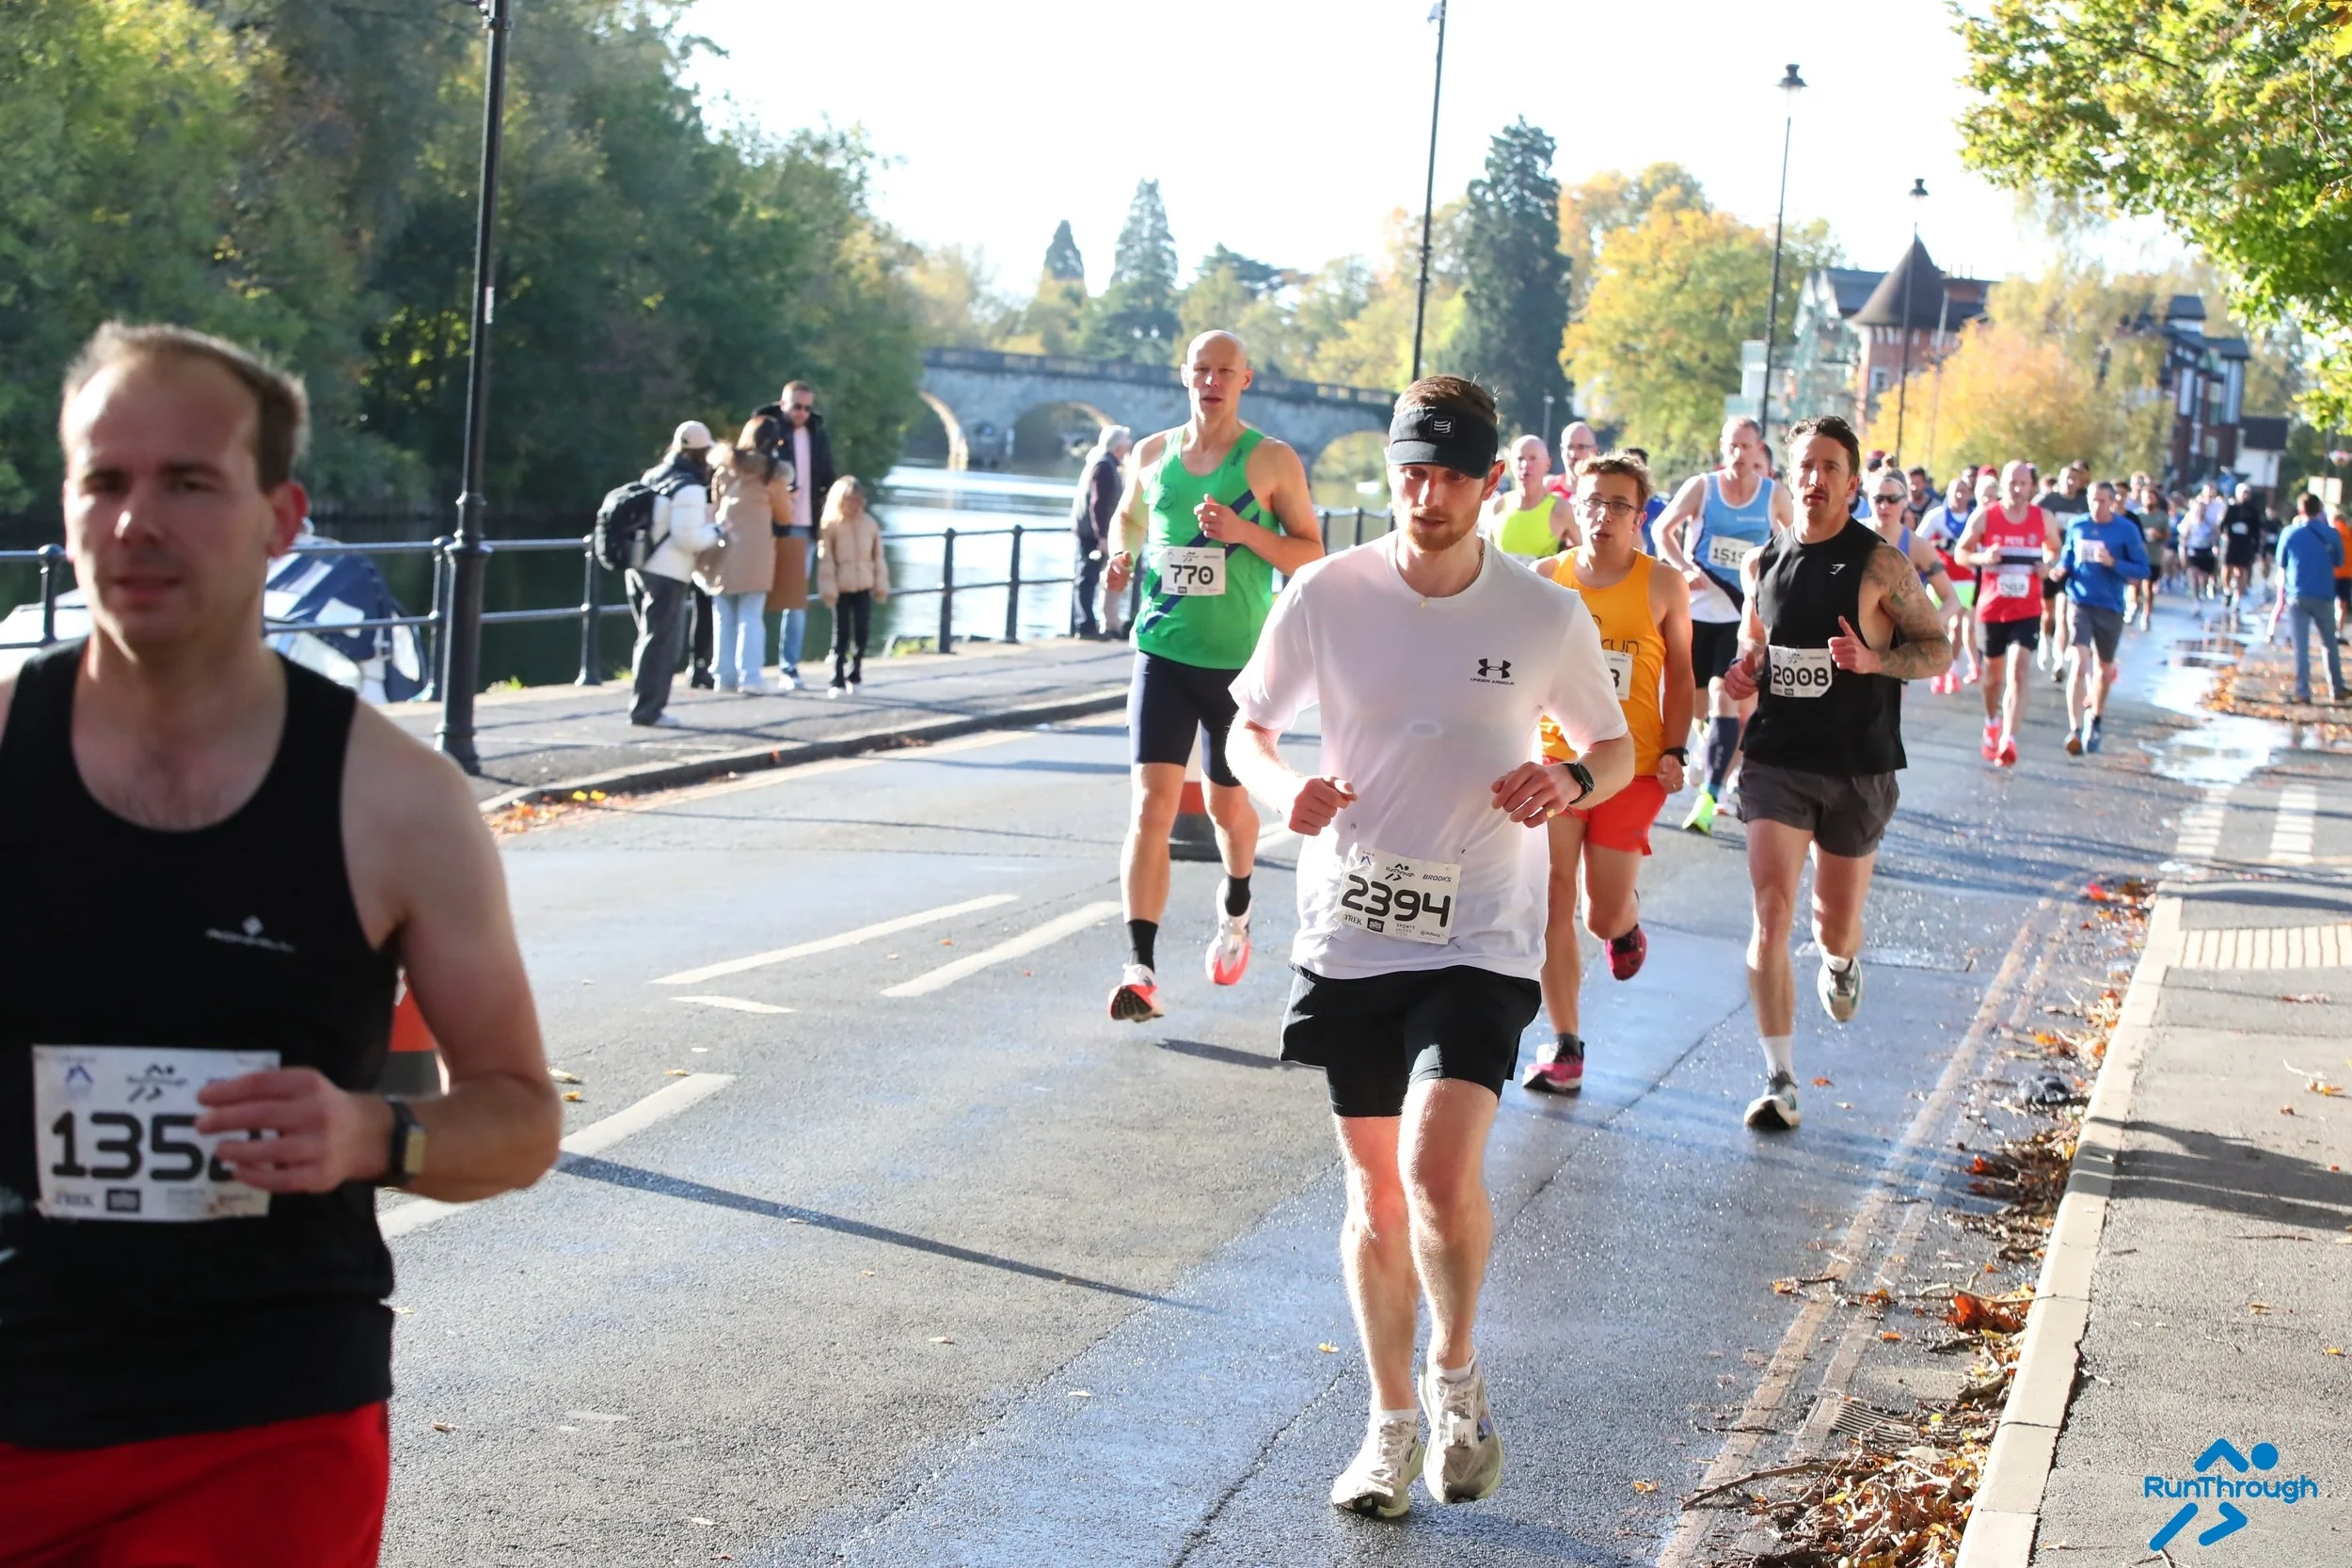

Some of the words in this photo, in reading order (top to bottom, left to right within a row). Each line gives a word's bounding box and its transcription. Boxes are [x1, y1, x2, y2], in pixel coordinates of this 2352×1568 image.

[1169, 563, 1215, 586] 770
[1772, 663, 1830, 687] 2008
[1422, 873, 1453, 883] BROOKS
[1341, 873, 1452, 928] 2394
[1343, 914, 1363, 927] TREK
